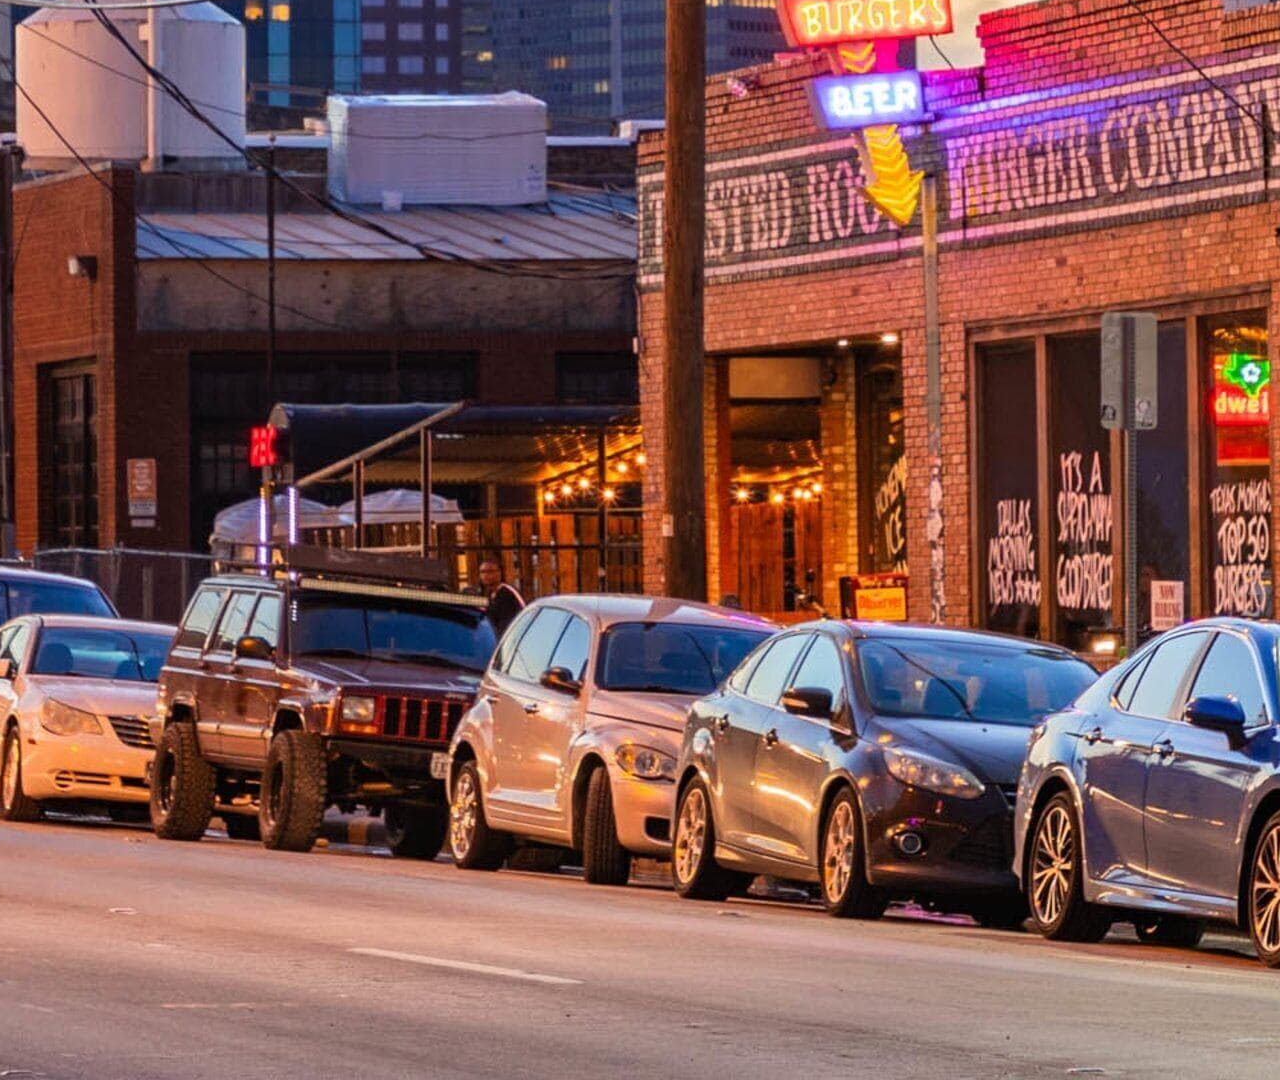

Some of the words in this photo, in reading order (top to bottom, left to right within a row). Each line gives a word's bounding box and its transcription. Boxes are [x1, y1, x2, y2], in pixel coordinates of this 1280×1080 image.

[827, 79, 918, 118] BEER
[648, 170, 792, 264] TSTED
[1089, 451, 1103, 493] A
[1218, 517, 1246, 565] TOP
[1247, 515, 1269, 562] 50
